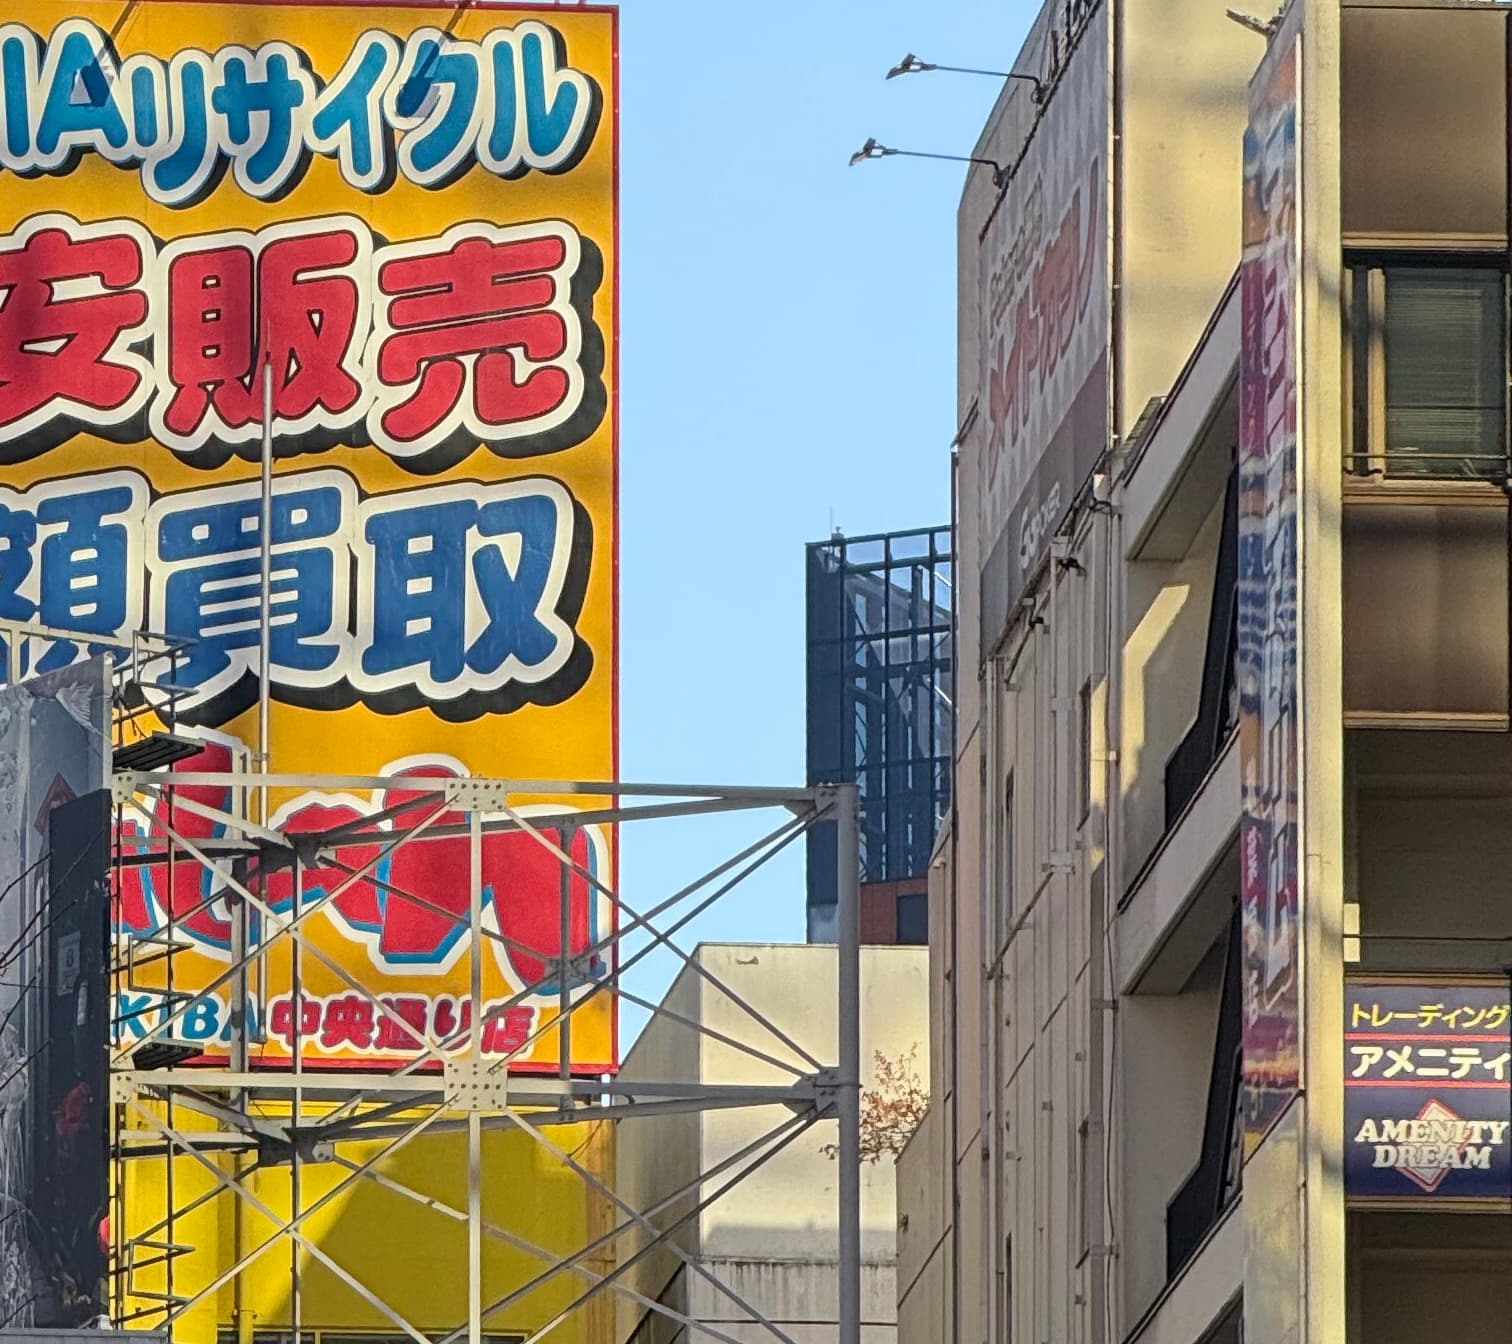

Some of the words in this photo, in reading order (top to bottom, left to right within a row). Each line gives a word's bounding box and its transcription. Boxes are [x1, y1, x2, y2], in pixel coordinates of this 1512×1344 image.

[1351, 1003, 1509, 1031] トレーディング
[1350, 1043, 1512, 1080] アメニティ
[1354, 1118, 1510, 1146] AMENITY
[1372, 1144, 1492, 1171] DREAM
